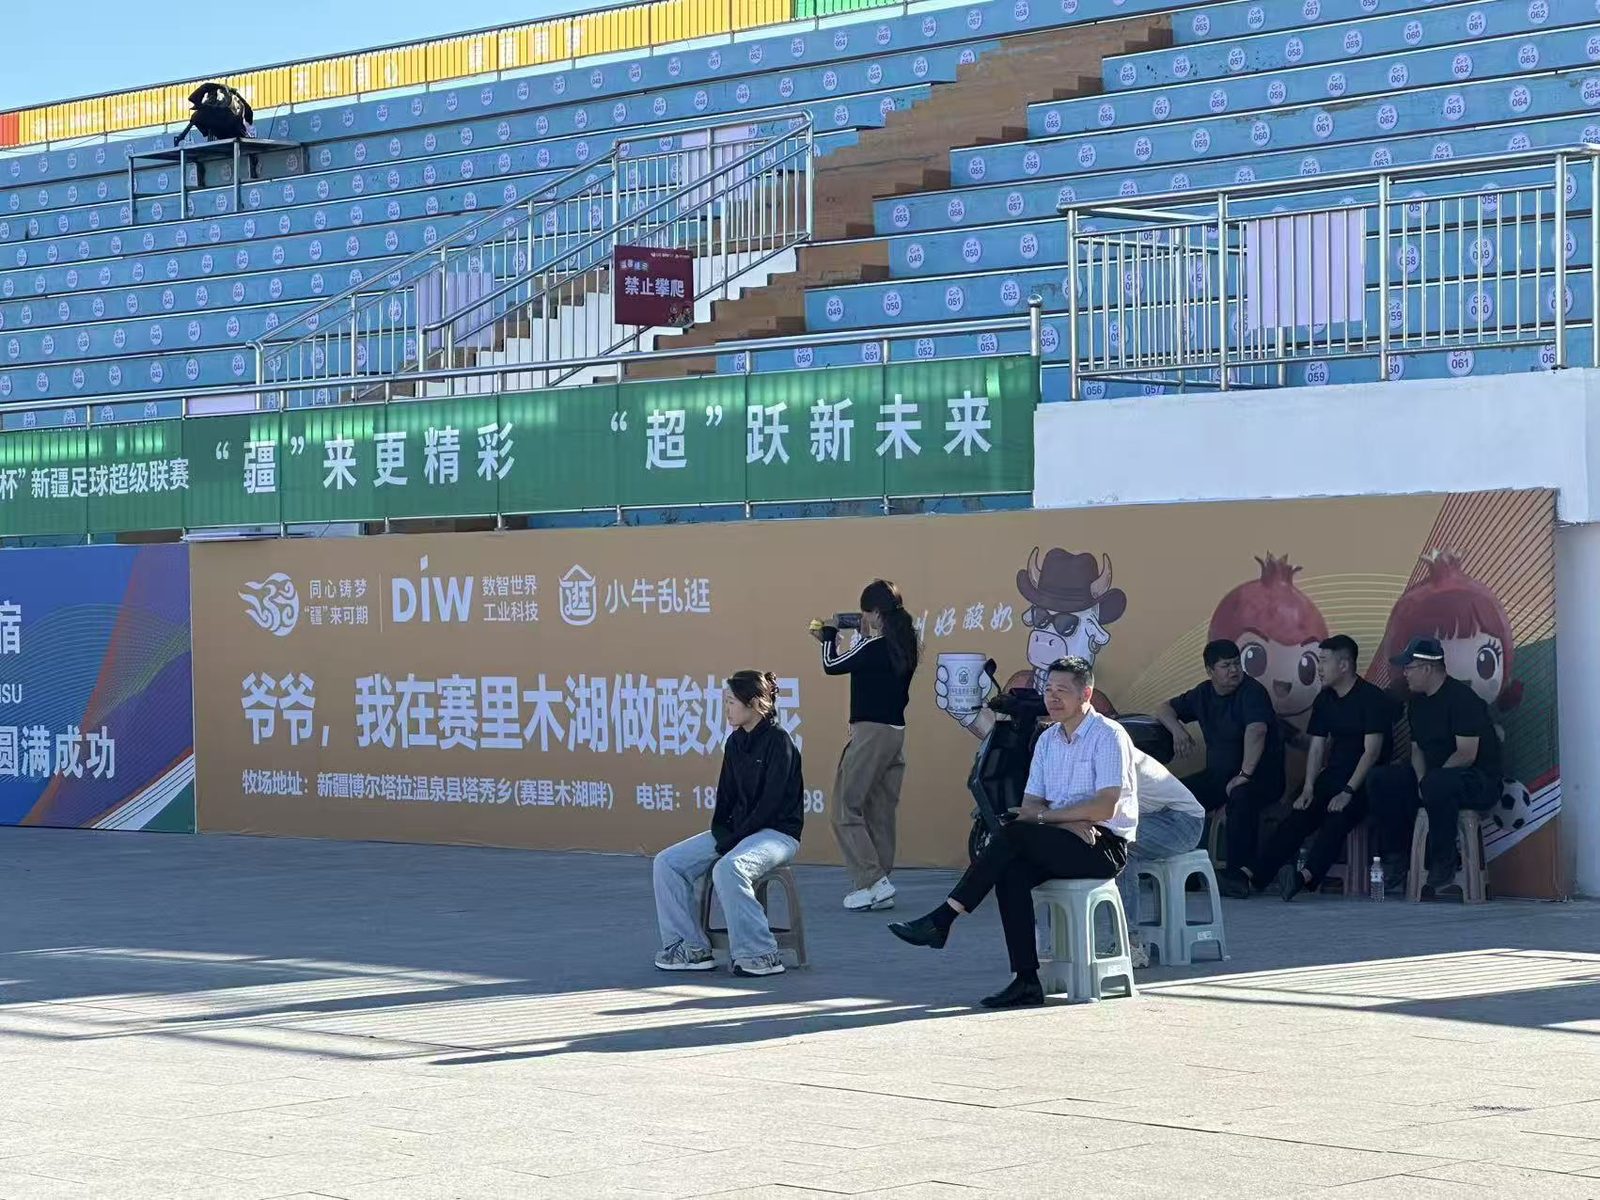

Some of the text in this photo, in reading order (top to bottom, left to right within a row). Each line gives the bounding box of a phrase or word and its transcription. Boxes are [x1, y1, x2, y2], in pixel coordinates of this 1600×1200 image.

[1362, 0, 1376, 8] 058
[1530, 10, 1546, 18] 062
[1249, 16, 1263, 24] 056
[1195, 23, 1208, 31] 055
[1468, 22, 1483, 30] 061
[1406, 31, 1420, 39] 060
[1345, 40, 1359, 48] 059
[1287, 48, 1301, 56] 058
[1230, 57, 1243, 65] 057
[1520, 56, 1535, 64] 063
[1175, 65, 1188, 73] 056
[1454, 65, 1469, 74] 062
[1391, 73, 1405, 81] 061
[1329, 82, 1343, 91] 060
[1269, 90, 1283, 99] 059
[1584, 90, 1600, 98] 065
[1211, 99, 1225, 108] 058
[1512, 98, 1527, 106] 064
[1154, 107, 1167, 115] 057
[1446, 106, 1462, 115] 063
[1100, 114, 1113, 122] 056
[1380, 115, 1394, 124] 062
[1316, 123, 1330, 132] 061
[1253, 131, 1267, 140] 060
[1194, 139, 1208, 148] 059
[1136, 147, 1150, 156] 058
[624, 275, 685, 298] 禁止攀爬
[828, 308, 841, 316] 049
[797, 355, 810, 363] 050
[865, 352, 877, 361] 051
[1452, 359, 1469, 369] 061
[1307, 373, 1324, 383] 059
[1086, 386, 1102, 395] 056
[1145, 385, 1160, 394] 057
[309, 578, 368, 599] 同心铸梦
[481, 574, 538, 597] 数智世界
[604, 577, 711, 615] 小牛乱逛
[483, 601, 539, 622] 工业科技
[0, 683, 22, 704] SU
[0, 724, 116, 779] 圆满成功
